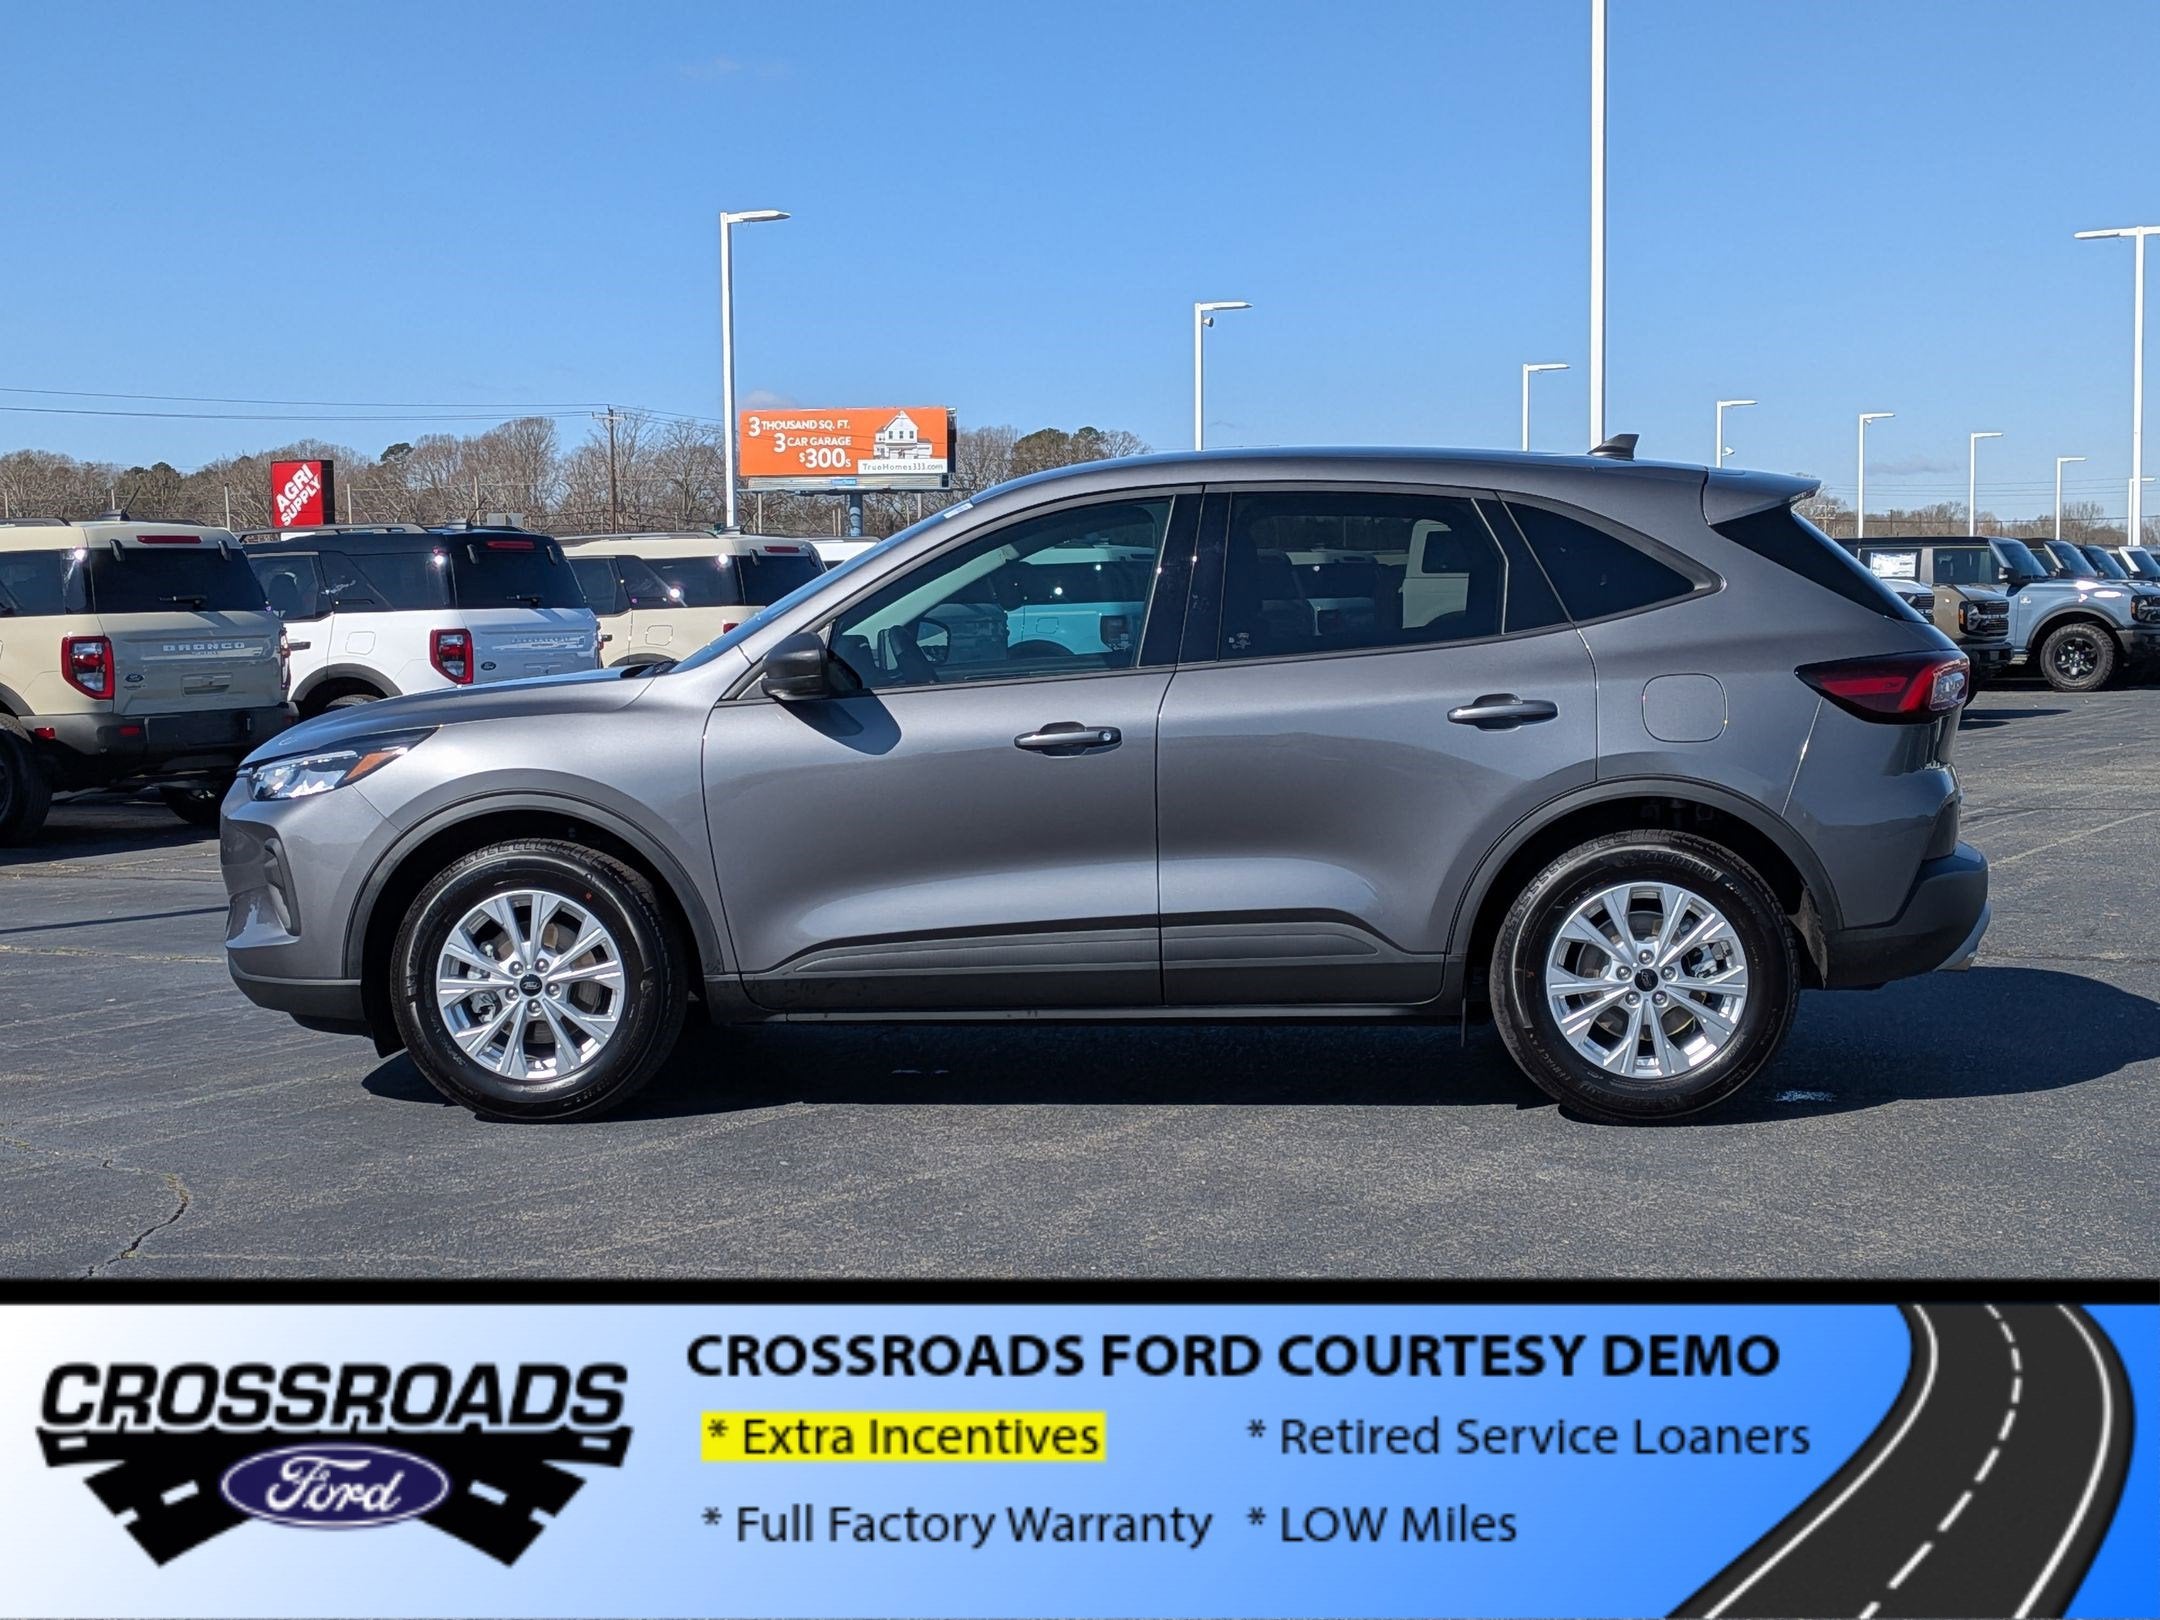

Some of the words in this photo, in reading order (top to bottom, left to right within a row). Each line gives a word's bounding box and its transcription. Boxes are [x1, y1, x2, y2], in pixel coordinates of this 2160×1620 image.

[748, 416, 761, 437] 3
[761, 420, 818, 431] THOUSAND
[818, 420, 836, 432] SQ.
[837, 419, 851, 430] FT.
[773, 432, 786, 453] 3
[787, 436, 808, 447] CAR
[810, 436, 852, 446] GARAGE
[862, 462, 944, 472] TrueHomes333.com
[276, 463, 314, 513] AGRI
[280, 474, 321, 527] SUPPLY
[162, 641, 245, 652] BRONCO
